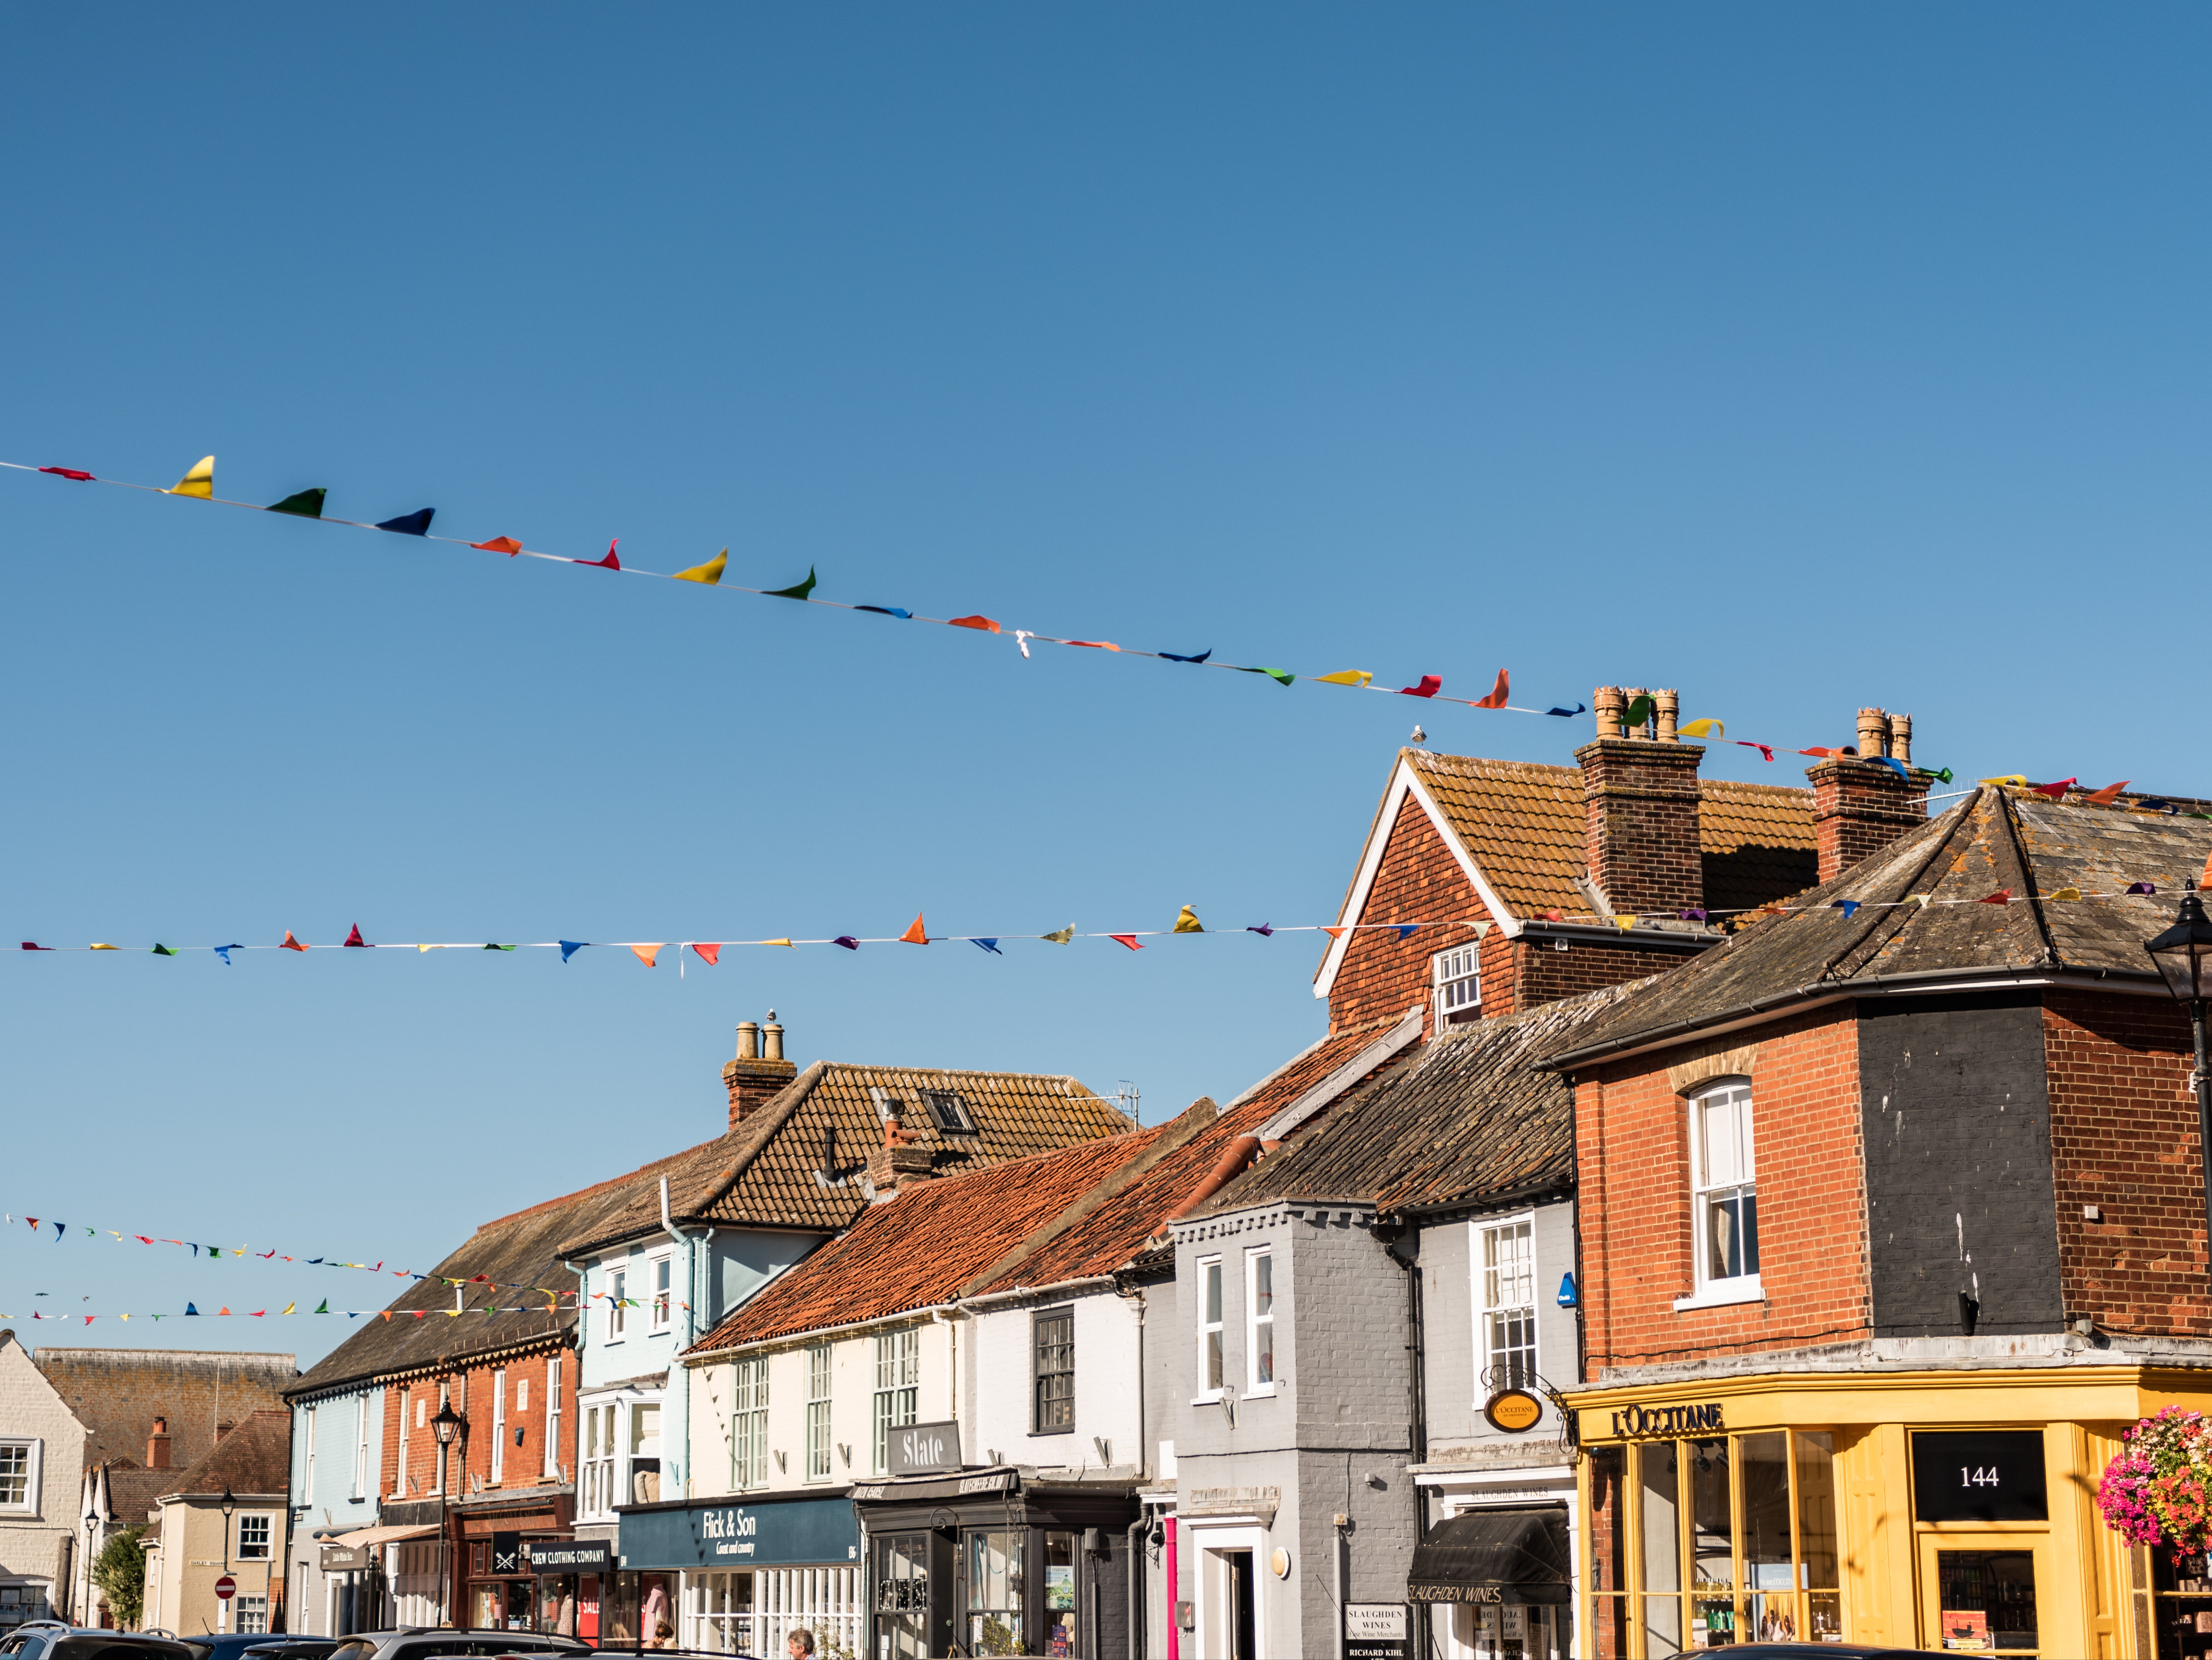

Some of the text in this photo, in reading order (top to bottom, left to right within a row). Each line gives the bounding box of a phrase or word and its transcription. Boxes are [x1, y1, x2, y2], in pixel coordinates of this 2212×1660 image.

[1611, 1403, 1723, 1435] L'OCCITANE
[903, 1431, 943, 1466] Slate
[1961, 1467, 1999, 1486] 144
[1471, 1487, 1548, 1500] SLAUGHDEN WINES
[703, 1509, 756, 1538] Flick & Son
[532, 1550, 604, 1565] CREW CLOTHING COMPANY
[716, 1540, 755, 1557] Coast and country
[1409, 1585, 1501, 1603] SLAUGHDEN WINES
